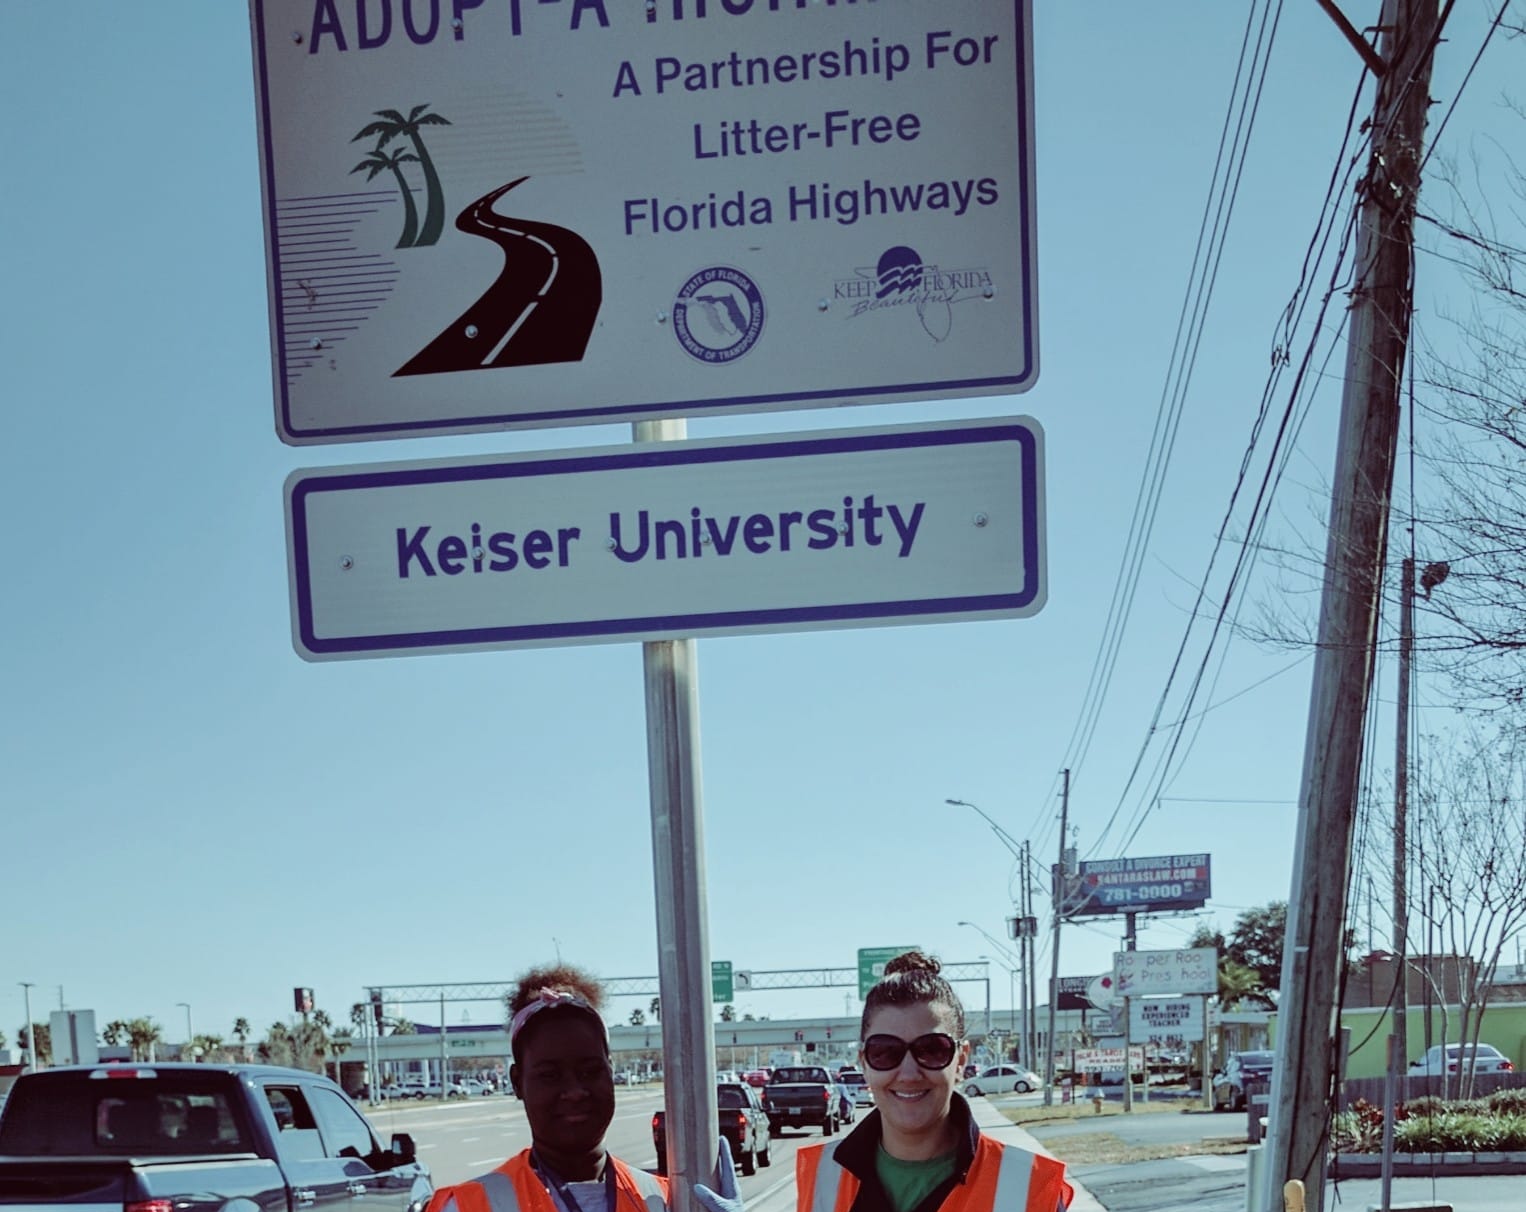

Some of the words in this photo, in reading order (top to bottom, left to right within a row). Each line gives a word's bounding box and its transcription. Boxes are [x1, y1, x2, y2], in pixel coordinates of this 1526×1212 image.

[612, 61, 642, 98] A
[655, 37, 910, 94] Partnership
[926, 31, 999, 69] For
[693, 110, 922, 159] Litter-Free
[624, 190, 773, 235] Florida
[788, 176, 999, 225] Highways
[704, 270, 717, 281] OF
[718, 270, 752, 291] FLORIDA
[833, 280, 878, 300] KEEP
[922, 271, 993, 293] FLORIDA
[674, 308, 705, 356] DEPARTMENT
[719, 301, 762, 360] TRANSPORTATION
[396, 522, 581, 579] Keiser
[610, 494, 926, 563] University
